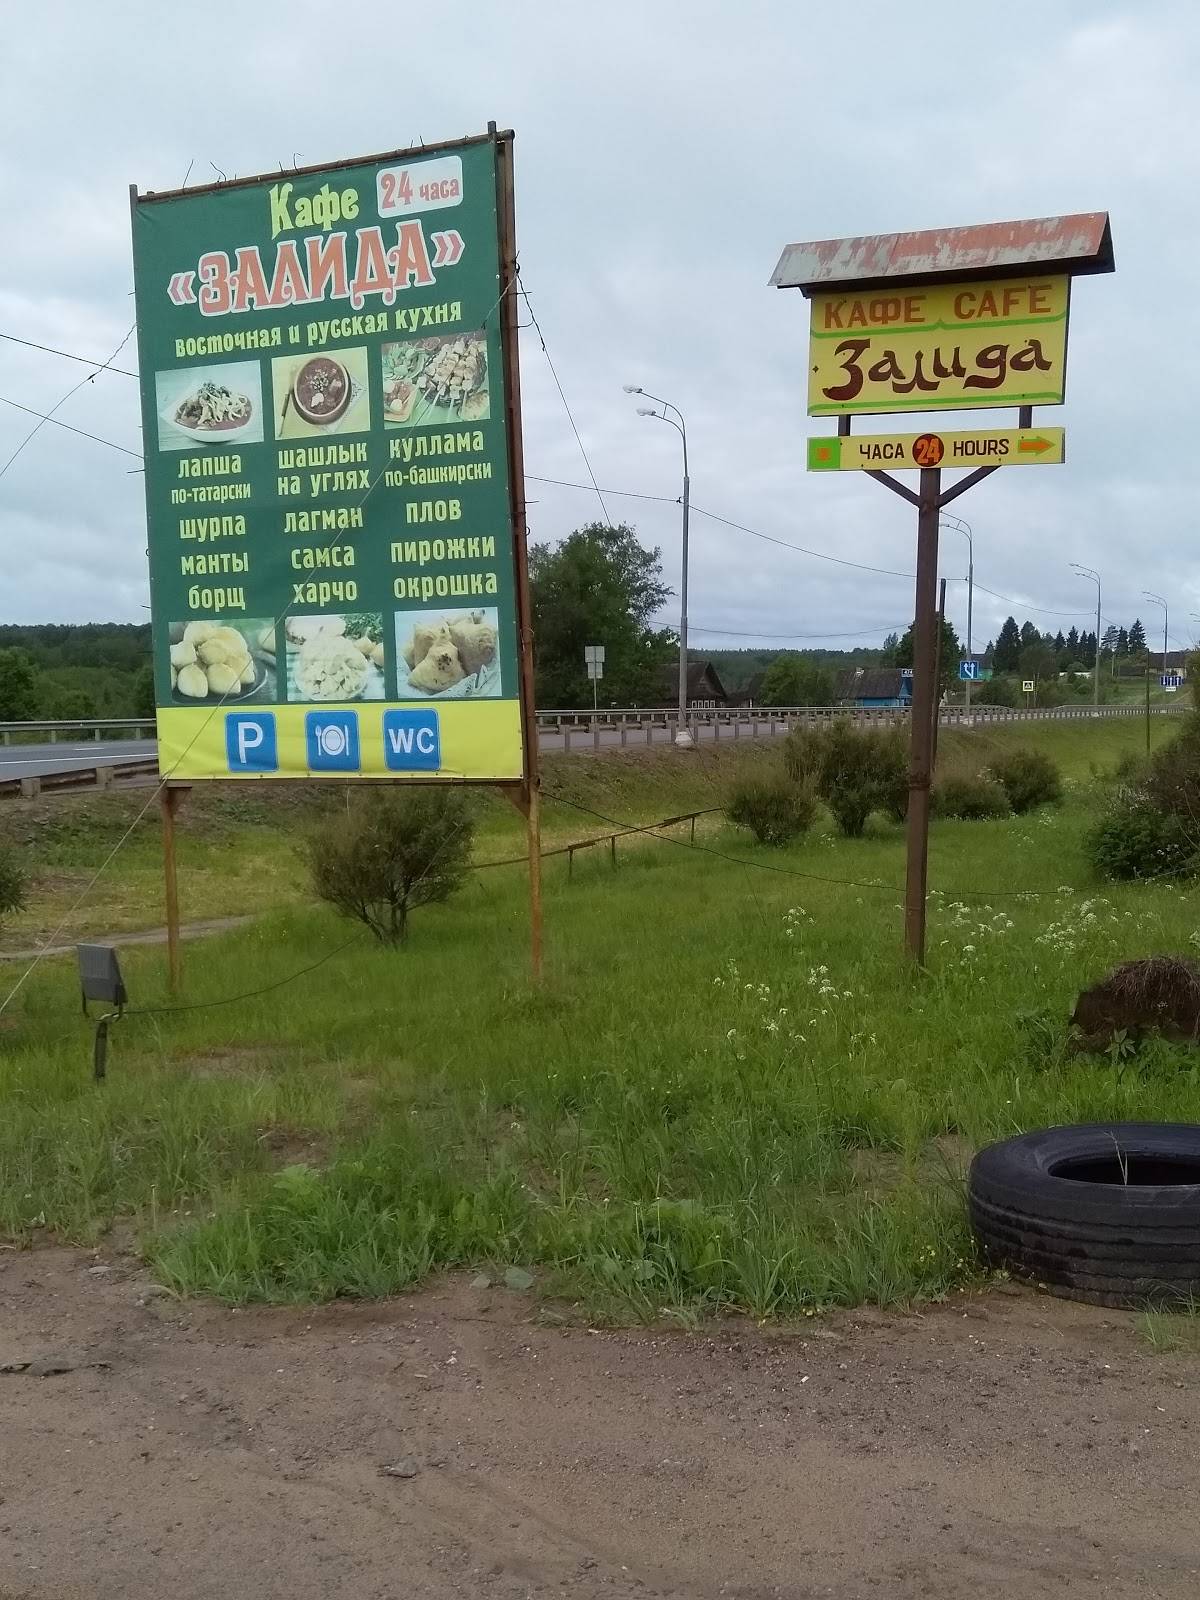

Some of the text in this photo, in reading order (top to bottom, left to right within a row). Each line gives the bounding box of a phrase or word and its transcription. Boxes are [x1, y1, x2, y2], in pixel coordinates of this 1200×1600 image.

[380, 170, 461, 210] 24 часа
[269, 182, 359, 239] Кафе
[824, 286, 1053, 329] КАФЕ CAFE
[175, 302, 462, 357] восточная и русская кухня
[277, 442, 368, 470] шашлык
[388, 430, 485, 462] куллама
[858, 438, 1010, 463] ЧАСА 24 HOURS
[177, 455, 242, 479] лапша
[384, 461, 493, 488] по-башкирски
[170, 482, 252, 505] по-татарски
[277, 469, 371, 498] на углях
[283, 507, 364, 534] лагман
[405, 499, 462, 524] плов
[179, 514, 246, 543] шурпа
[180, 552, 249, 576] манты
[290, 545, 356, 571] самса
[390, 535, 496, 567] пирожки
[187, 585, 246, 611] борщ
[292, 579, 358, 607] харчо
[393, 572, 498, 602] окрошка
[237, 722, 264, 764] P
[388, 728, 435, 754] WC
